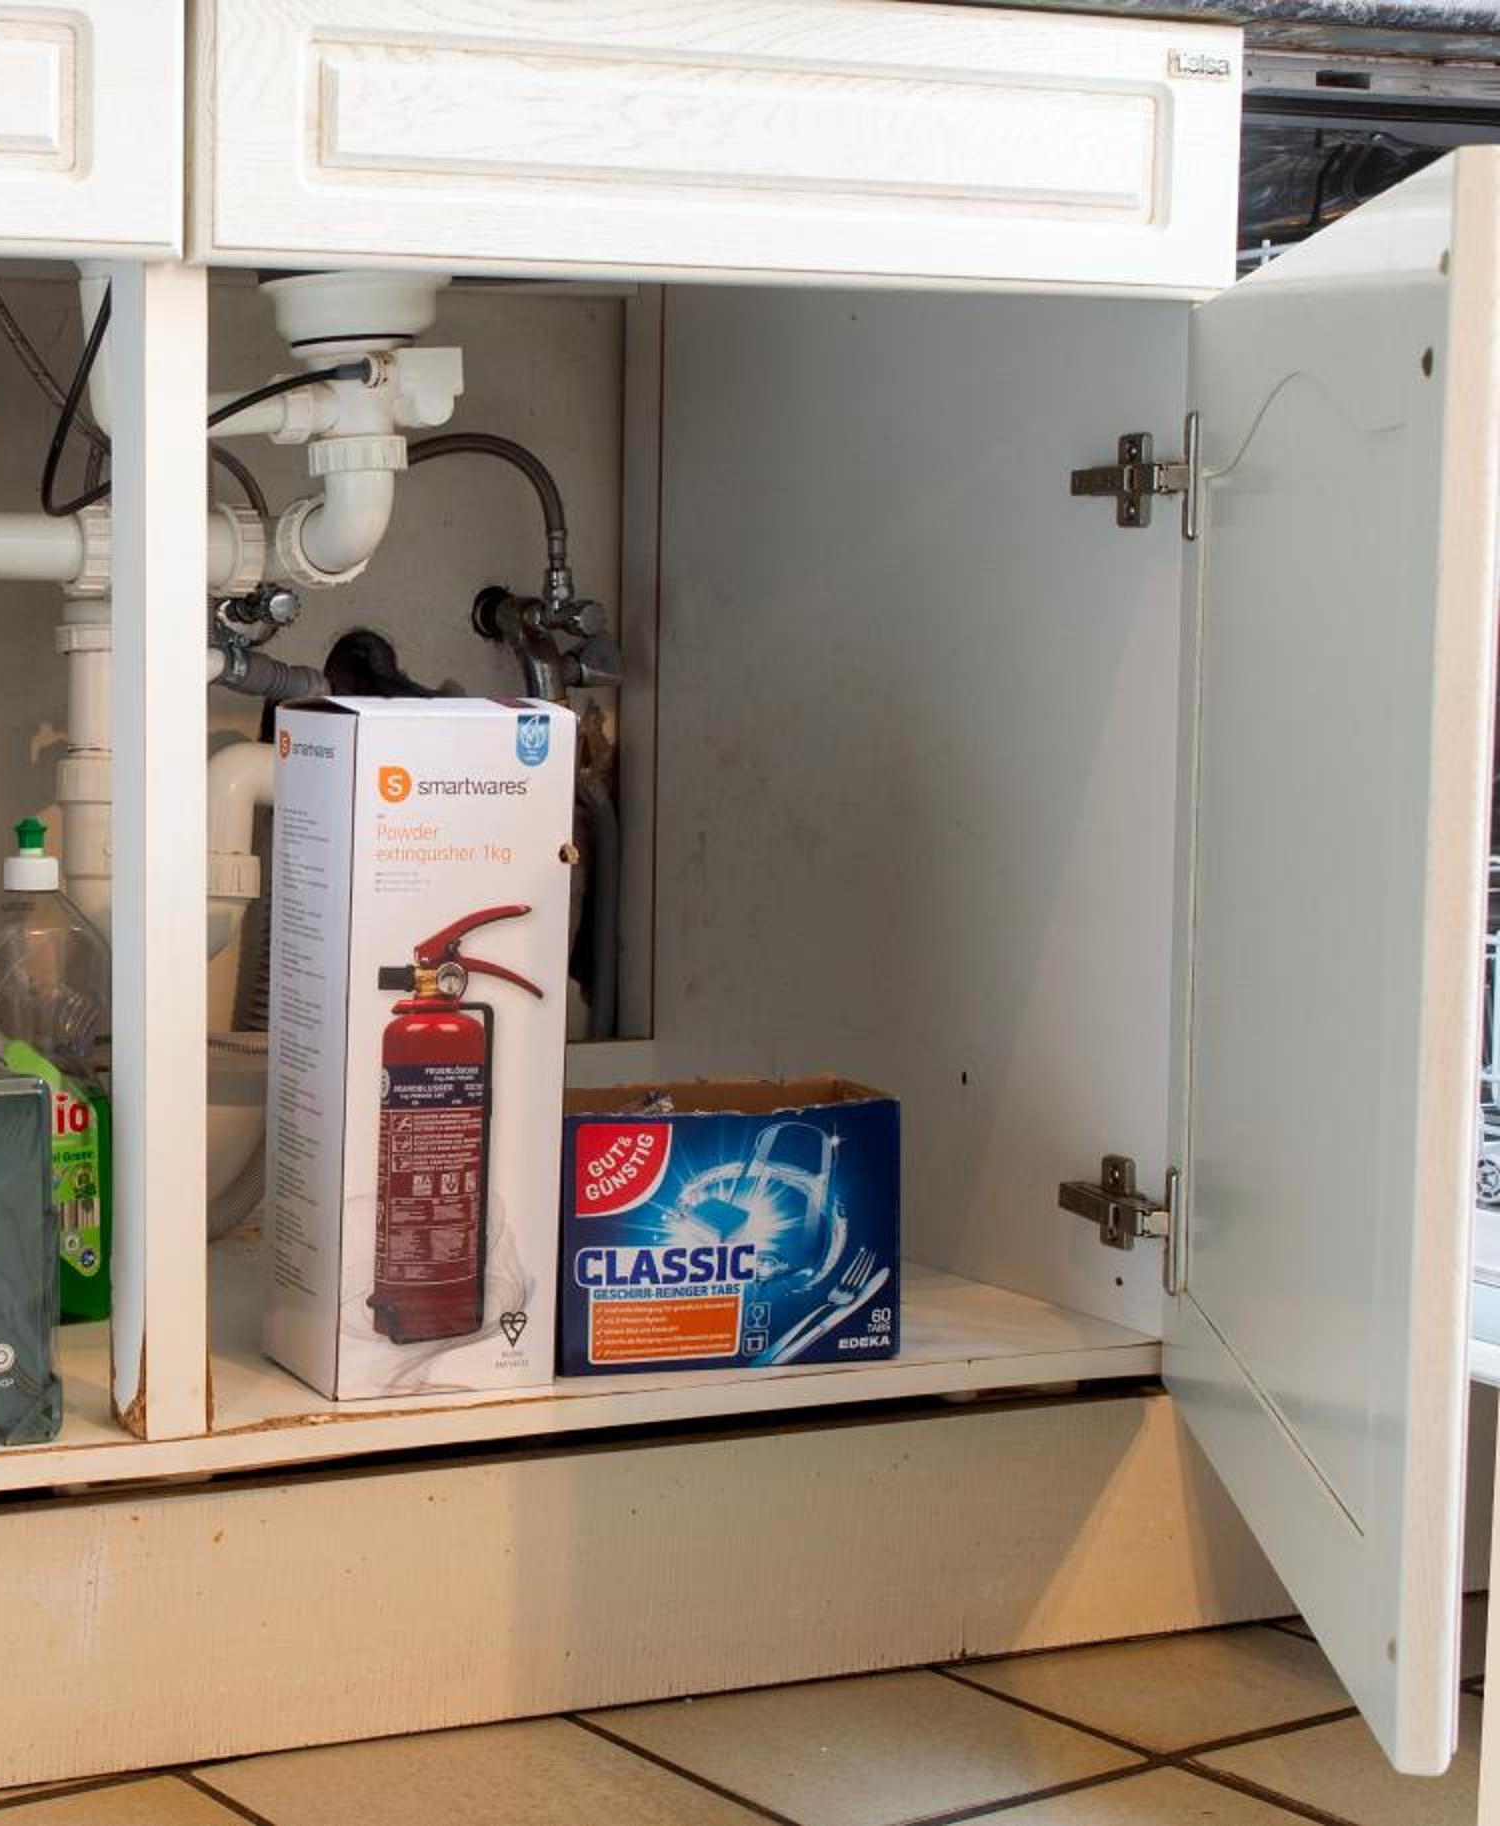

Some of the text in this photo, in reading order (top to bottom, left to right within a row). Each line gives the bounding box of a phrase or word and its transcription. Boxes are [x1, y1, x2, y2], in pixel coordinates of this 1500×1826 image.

[417, 776, 528, 797] smartwares
[376, 823, 439, 842] Powder
[374, 844, 512, 865] extinguisher 1kg
[584, 1132, 655, 1202] GÜNSTIG
[576, 1245, 755, 1287] CLASSIC
[711, 1283, 741, 1296] TABS
[871, 1308, 891, 1323] 60
[838, 1335, 891, 1349] EDEKA
